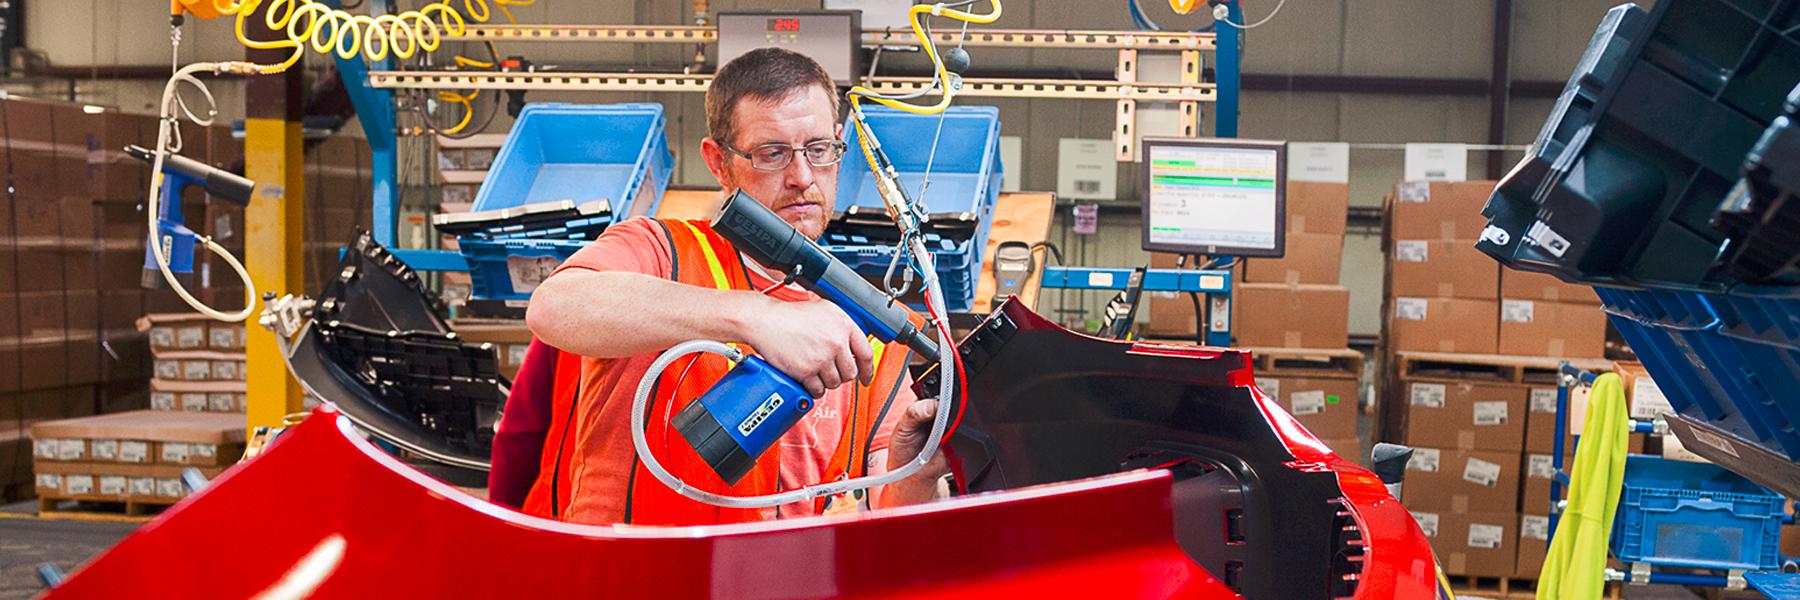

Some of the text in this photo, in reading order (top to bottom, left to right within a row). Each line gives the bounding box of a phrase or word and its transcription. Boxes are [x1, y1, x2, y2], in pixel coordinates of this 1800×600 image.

[734, 213, 778, 249] GESIPA
[744, 399, 780, 432] GESIPA
[813, 407, 836, 419] Air
